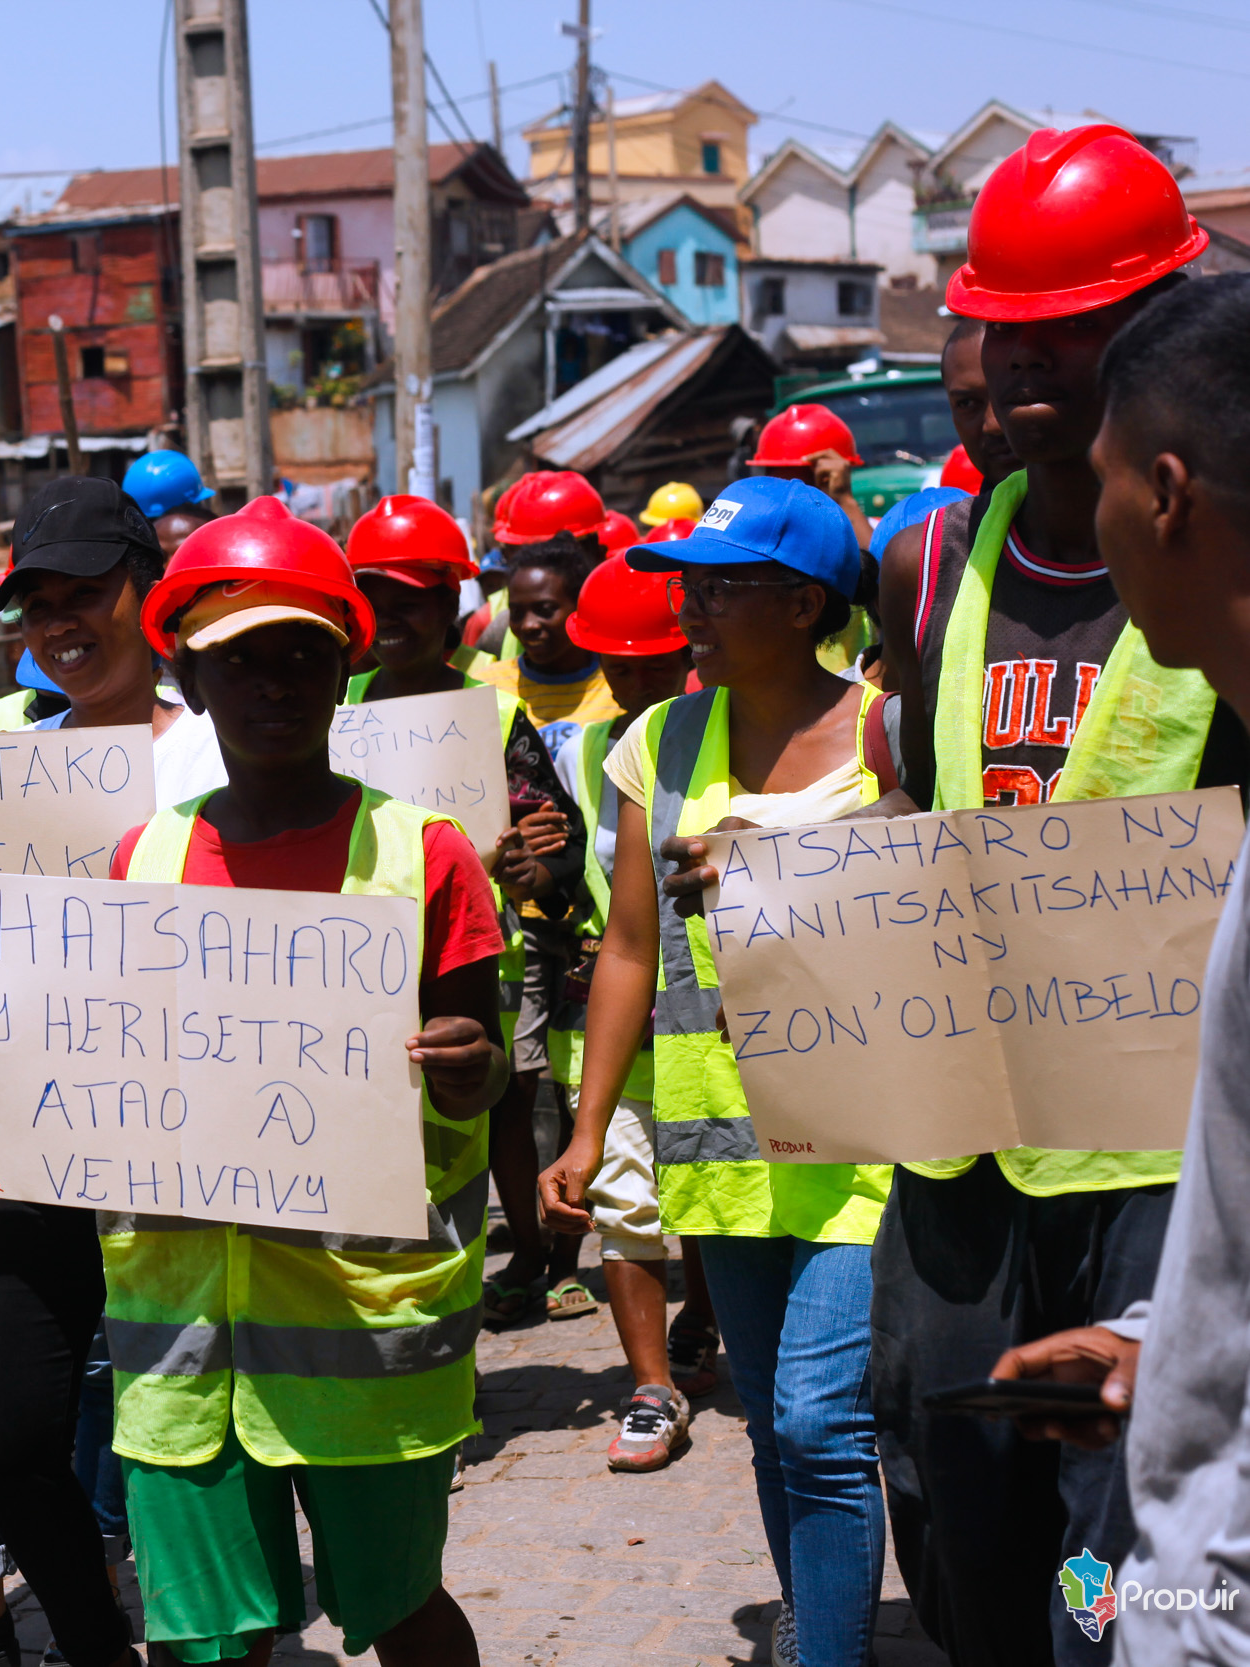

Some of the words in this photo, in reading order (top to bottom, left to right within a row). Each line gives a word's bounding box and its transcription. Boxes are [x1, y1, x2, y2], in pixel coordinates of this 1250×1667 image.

[328, 720, 468, 760] OTINA
[329, 707, 385, 735] ZA
[720, 814, 1071, 888] ATSAHARO
[1122, 804, 1203, 849] NY
[933, 933, 1008, 968] NY
[45, 992, 370, 1081] HERISETRA
[32, 1078, 188, 1131] ATAO
[768, 1138, 816, 1154] PRODUIR
[41, 1153, 329, 1215] VEHIVAVY
